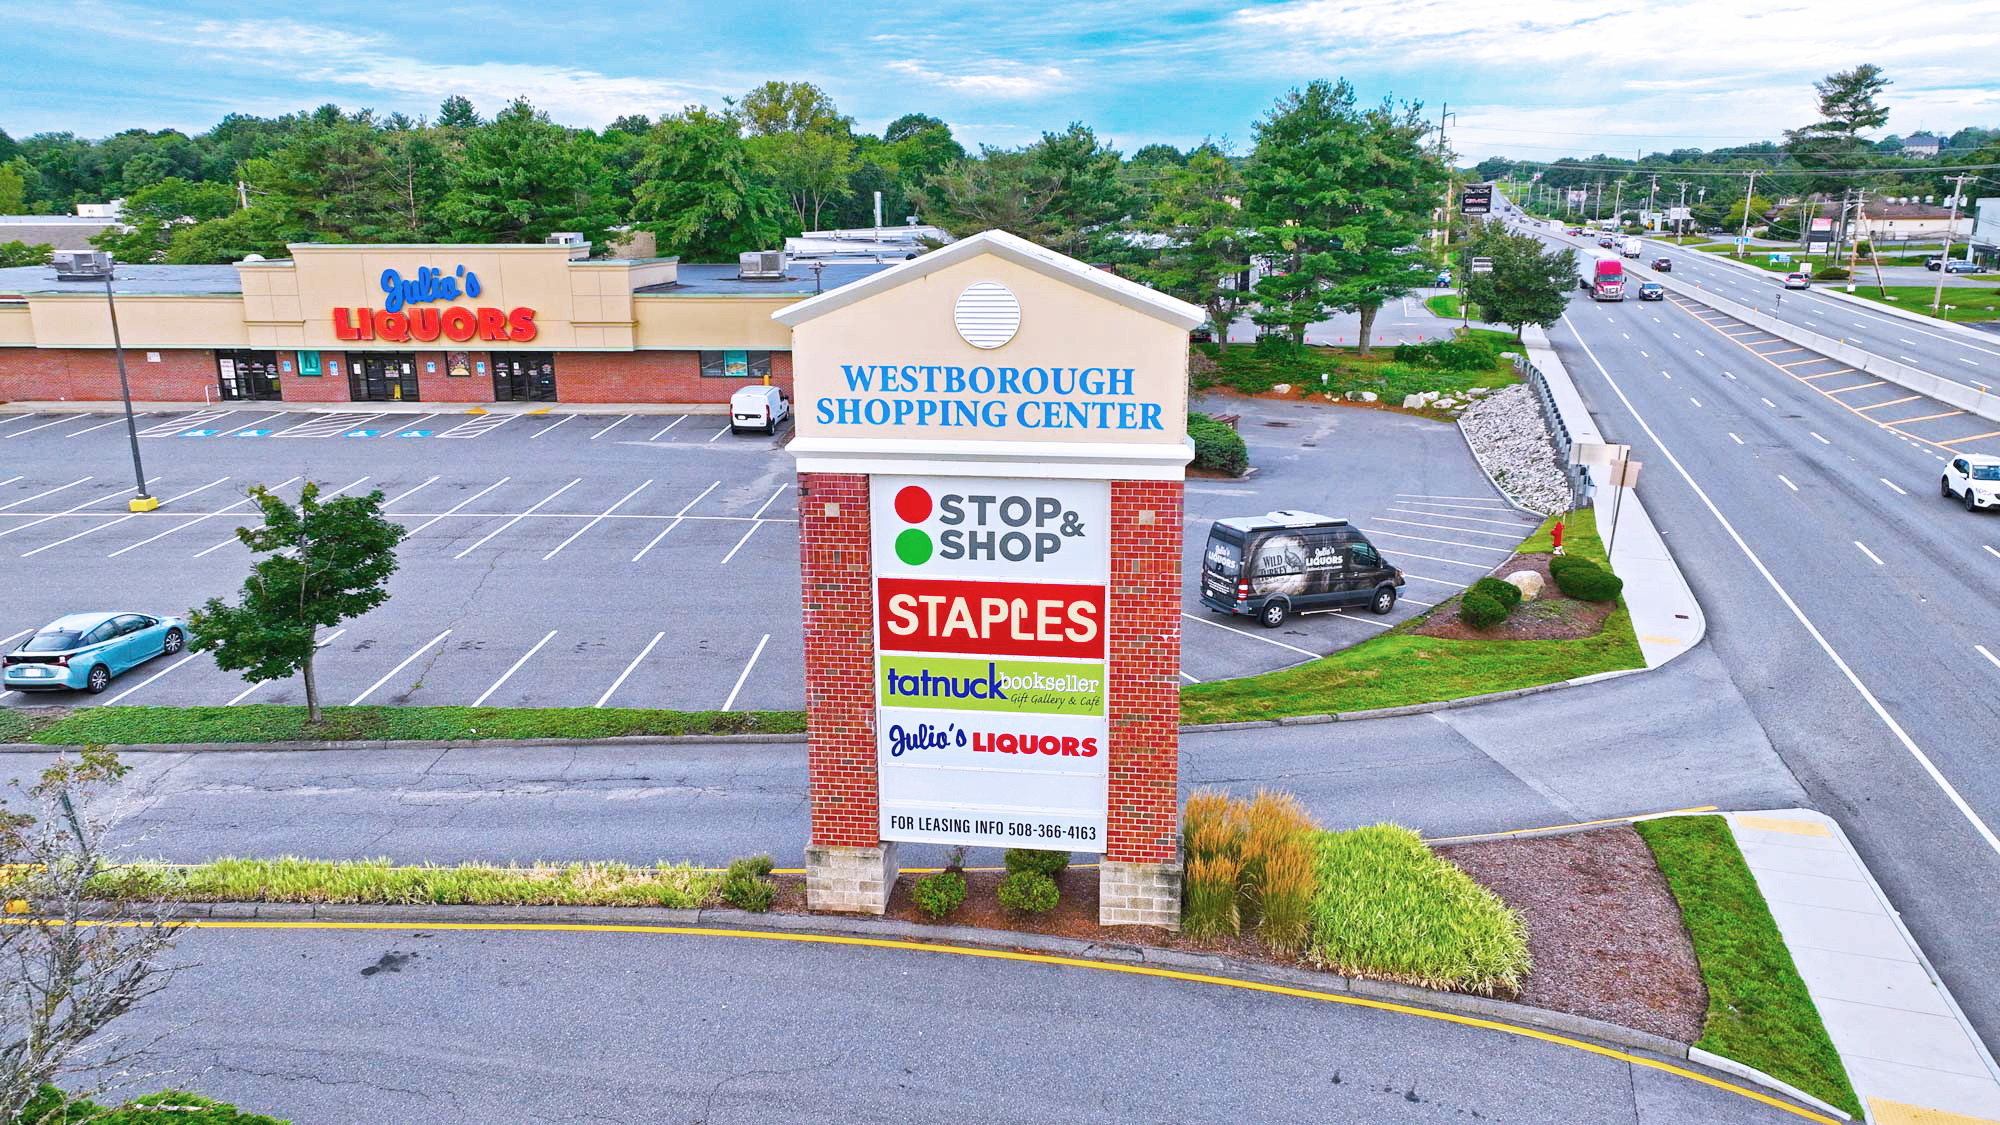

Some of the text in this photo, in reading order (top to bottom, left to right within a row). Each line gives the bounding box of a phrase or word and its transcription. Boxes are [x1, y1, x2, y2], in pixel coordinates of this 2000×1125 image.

[382, 265, 480, 313] Julio's
[334, 308, 537, 342] LIQUORS
[841, 365, 1135, 395] WESTBOROUGH
[817, 398, 1164, 430] SHOPPING CENTER
[939, 530, 1062, 563] SHOP
[1208, 551, 1236, 568] LIQUORS
[1263, 555, 1283, 568] WILD
[1306, 555, 1343, 566] LIQUORS
[887, 594, 1098, 642] STAPLES
[888, 662, 1100, 699] tatnuck bookseller
[1010, 693, 1101, 709] Gift Gallery & Café
[888, 723, 1098, 757] Julio's LIQUORS
[891, 815, 1097, 840] FOR LEASING INFO 508-366-4163
